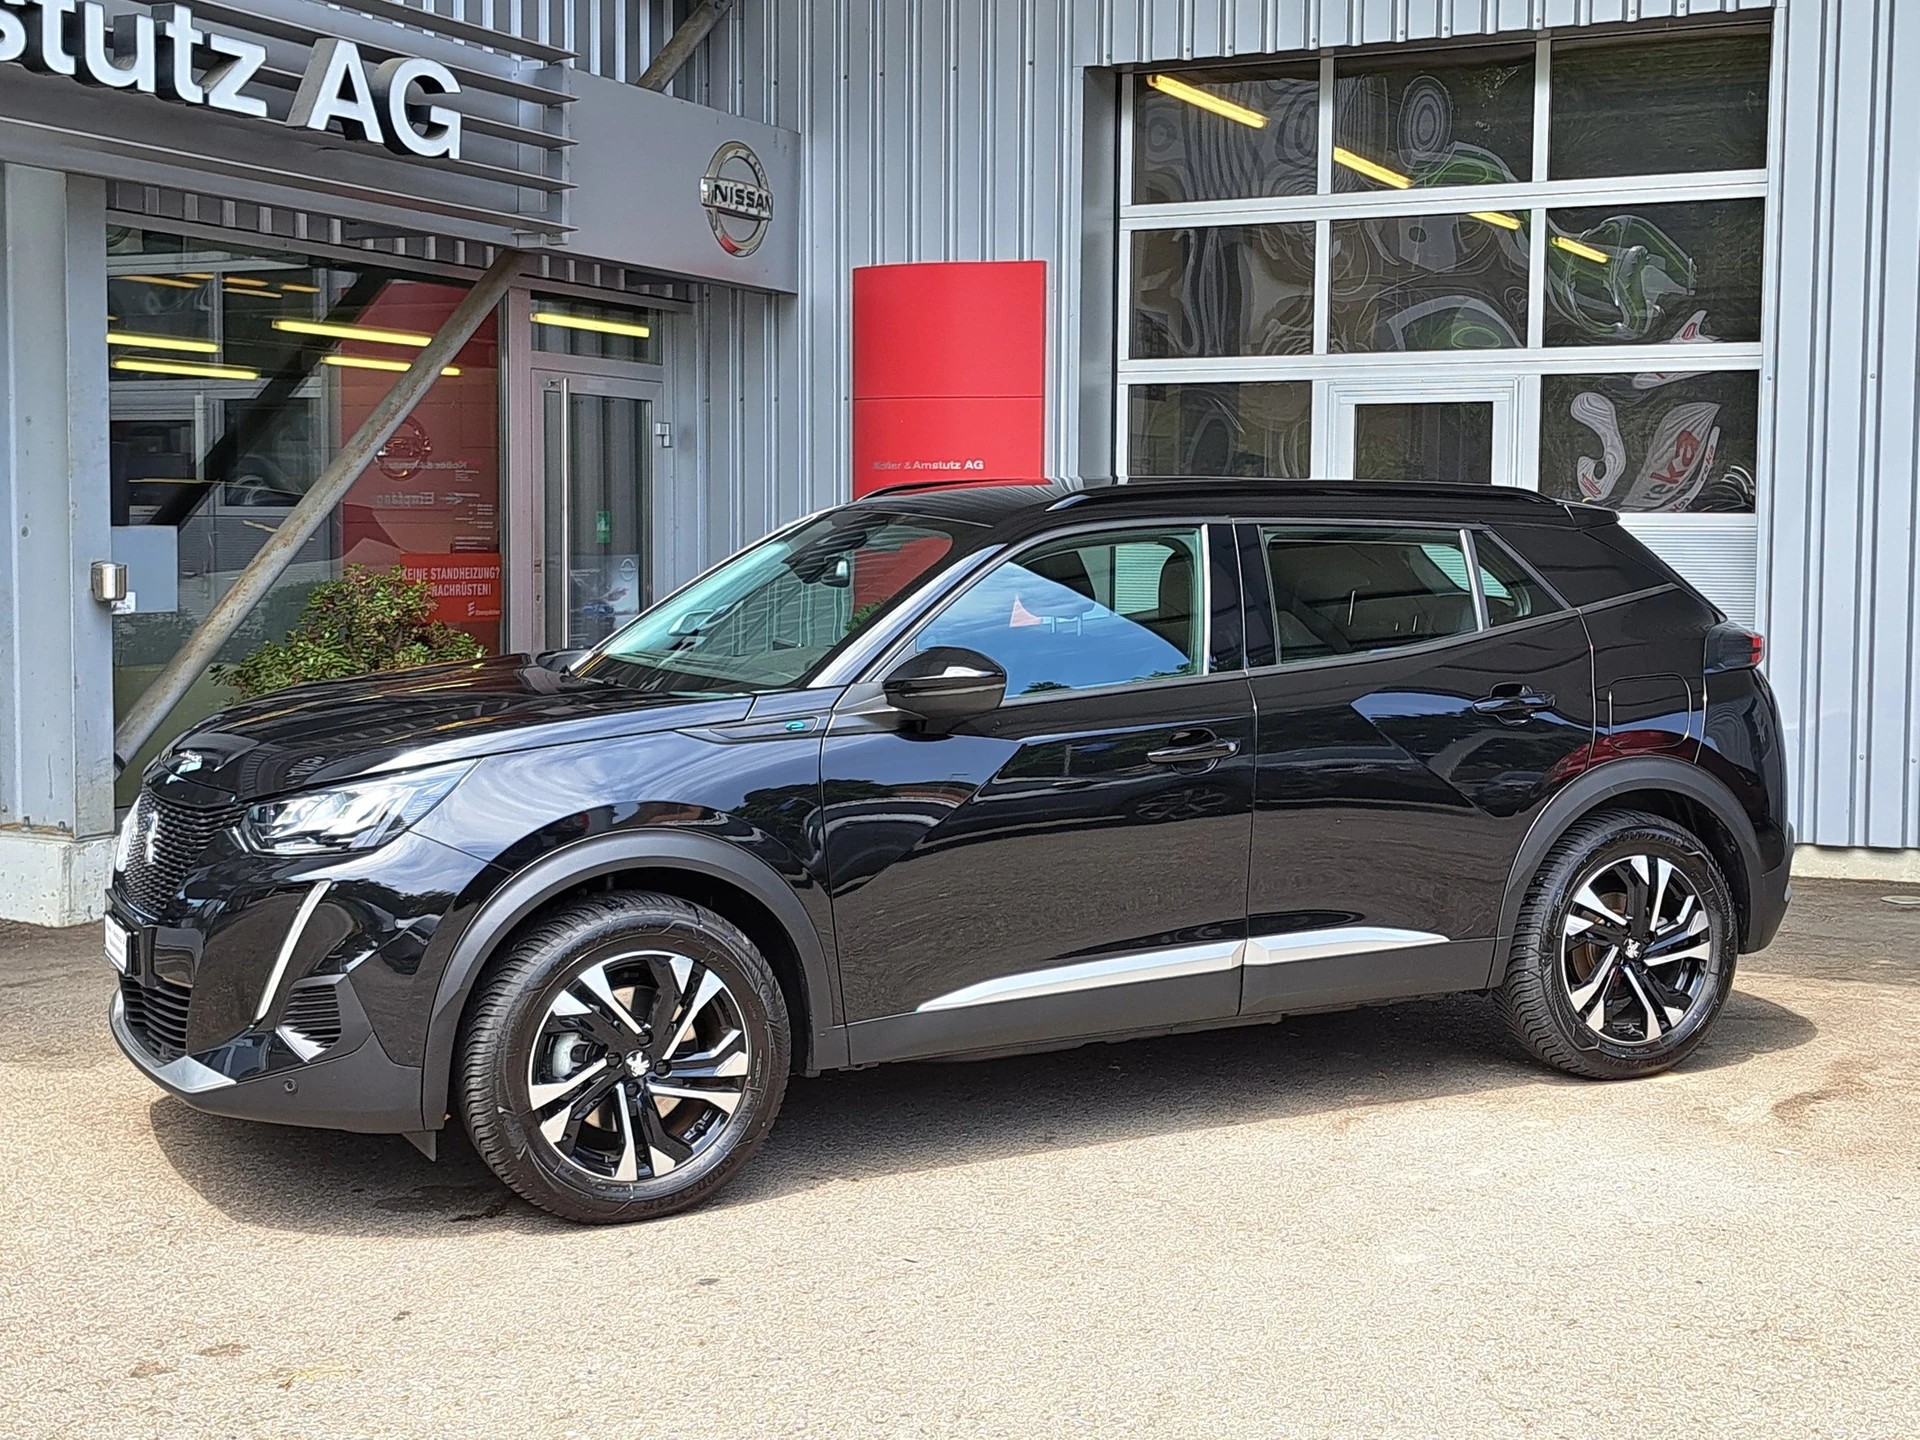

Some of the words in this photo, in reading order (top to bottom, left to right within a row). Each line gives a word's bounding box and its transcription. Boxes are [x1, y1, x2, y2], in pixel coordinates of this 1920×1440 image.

[306, 39, 462, 160] AG
[714, 183, 773, 214] NISSAN
[913, 460, 962, 470] Amstutz
[964, 460, 984, 470] AG
[430, 566, 500, 580] STANDHEIZUNG?
